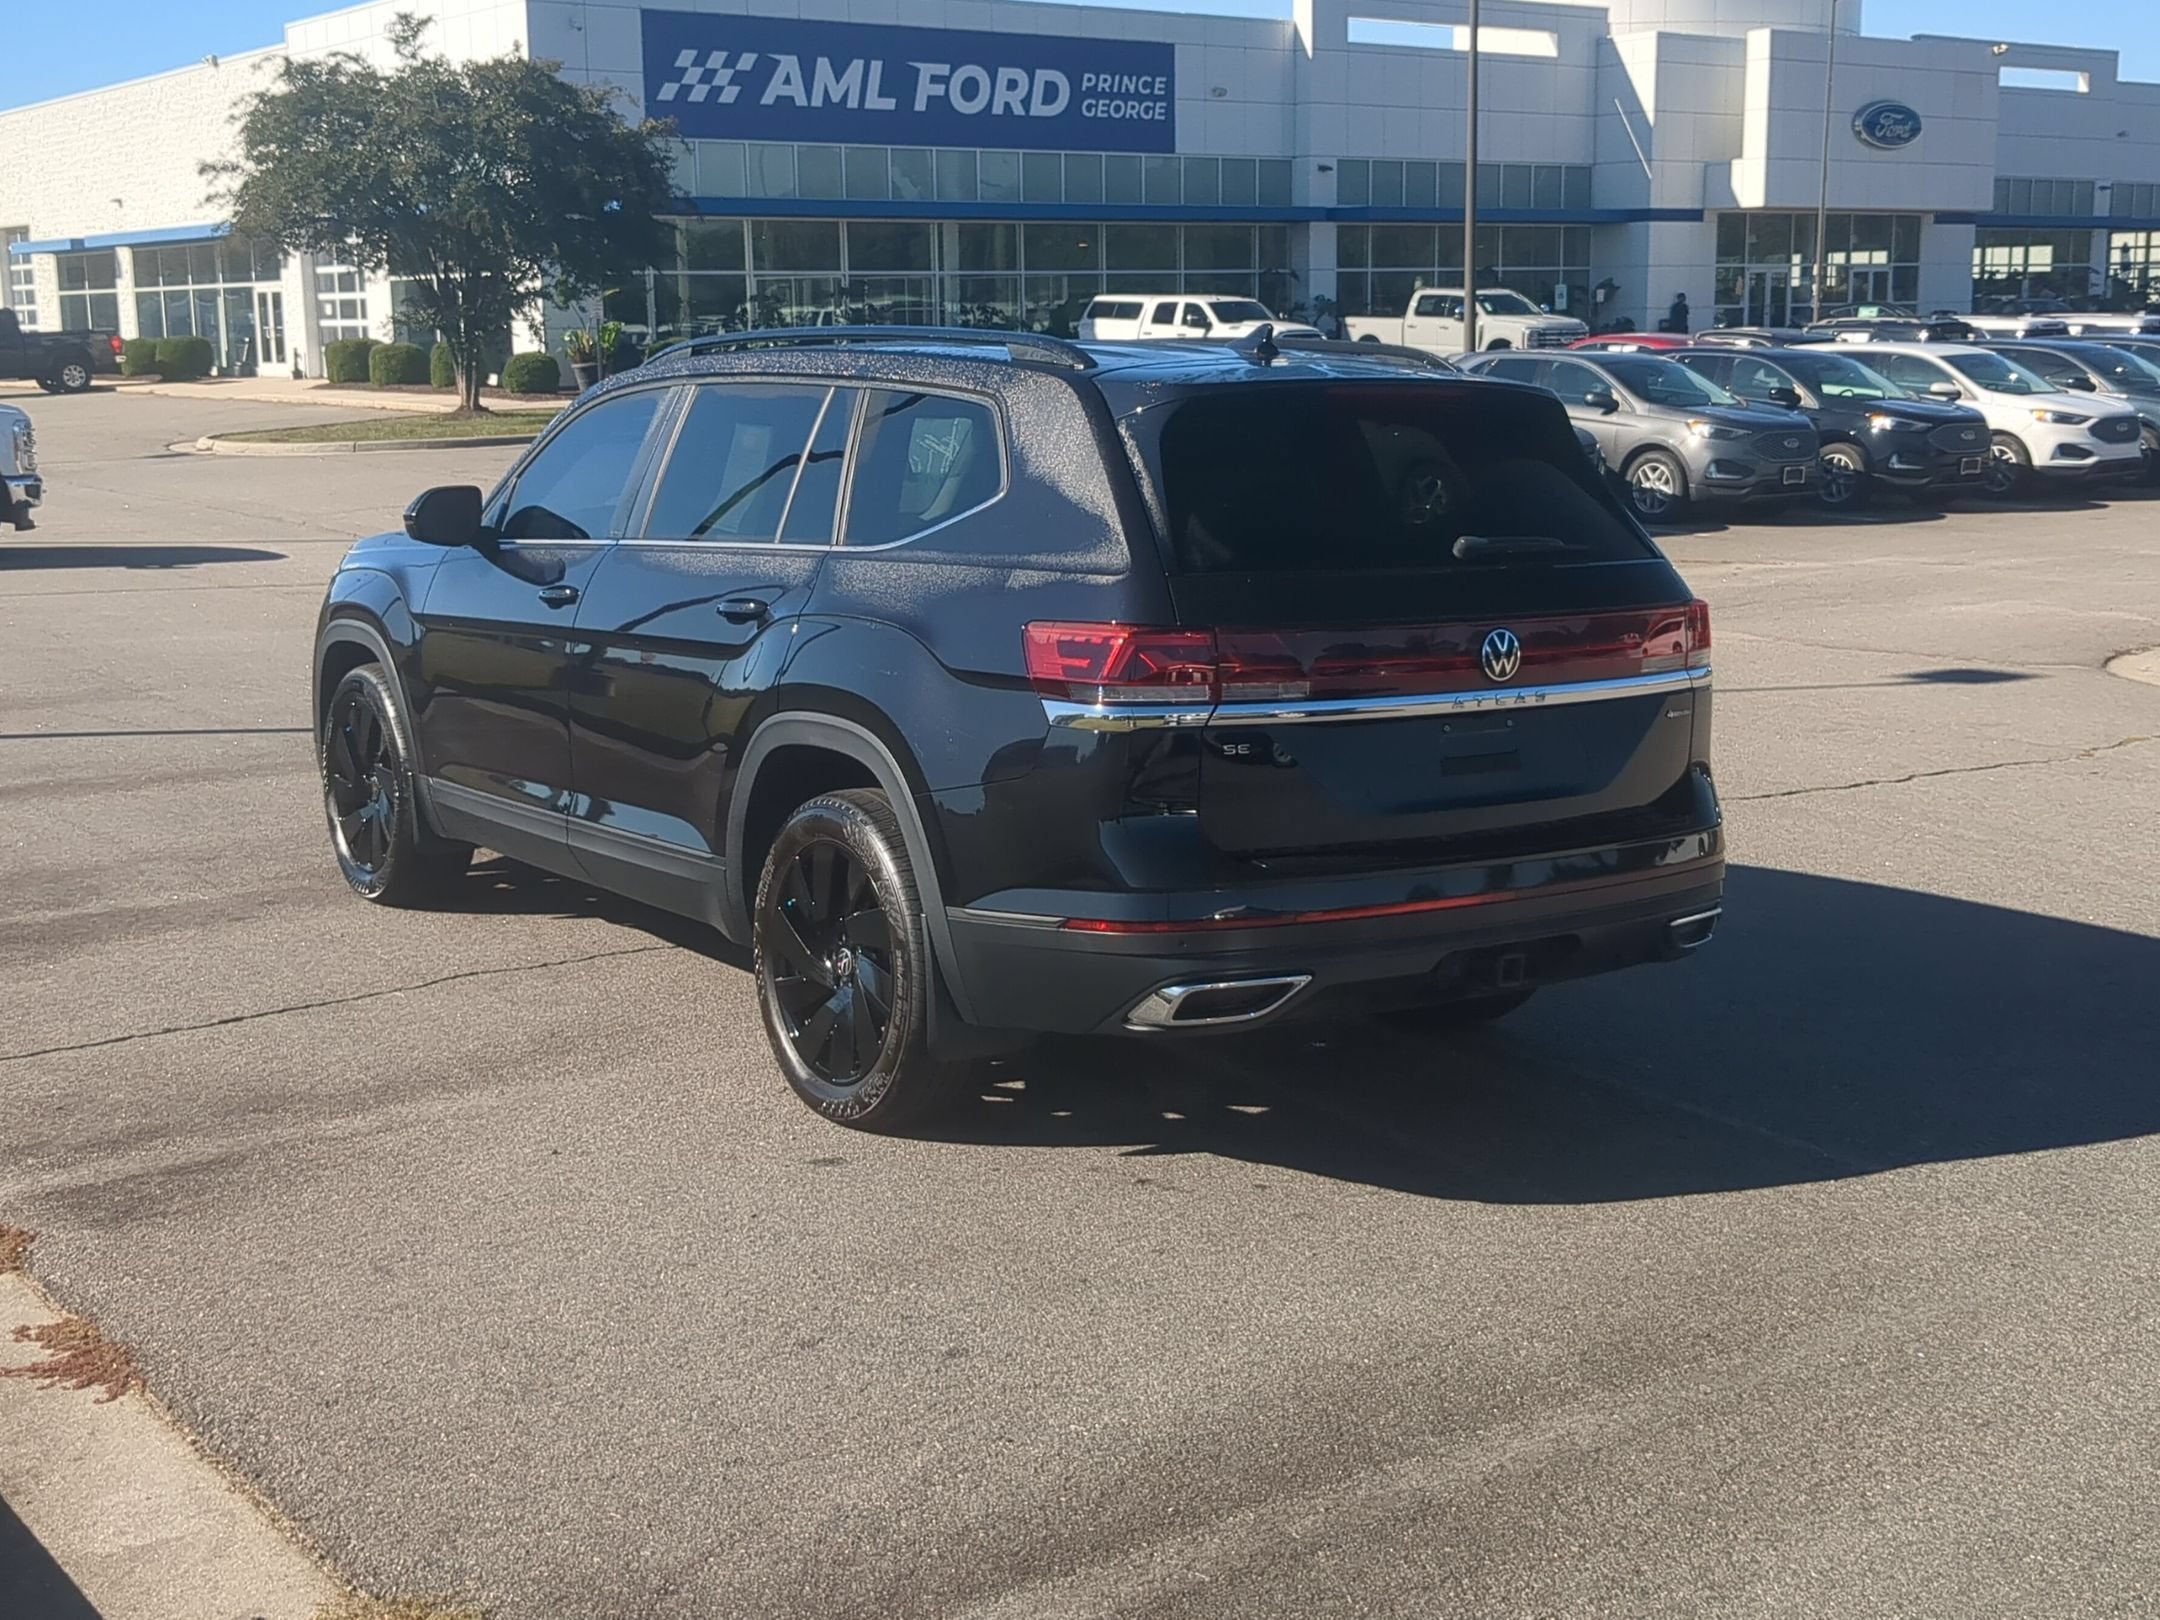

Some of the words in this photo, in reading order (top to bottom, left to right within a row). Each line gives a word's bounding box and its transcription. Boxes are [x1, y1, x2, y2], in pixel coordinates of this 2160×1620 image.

[760, 53, 897, 111] AML
[905, 61, 1071, 117] FORD
[1081, 73, 1167, 95] PRINCE
[1081, 98, 1167, 121] GEORGE
[1875, 112, 1913, 138] Ford
[1223, 744, 1251, 755] SE
